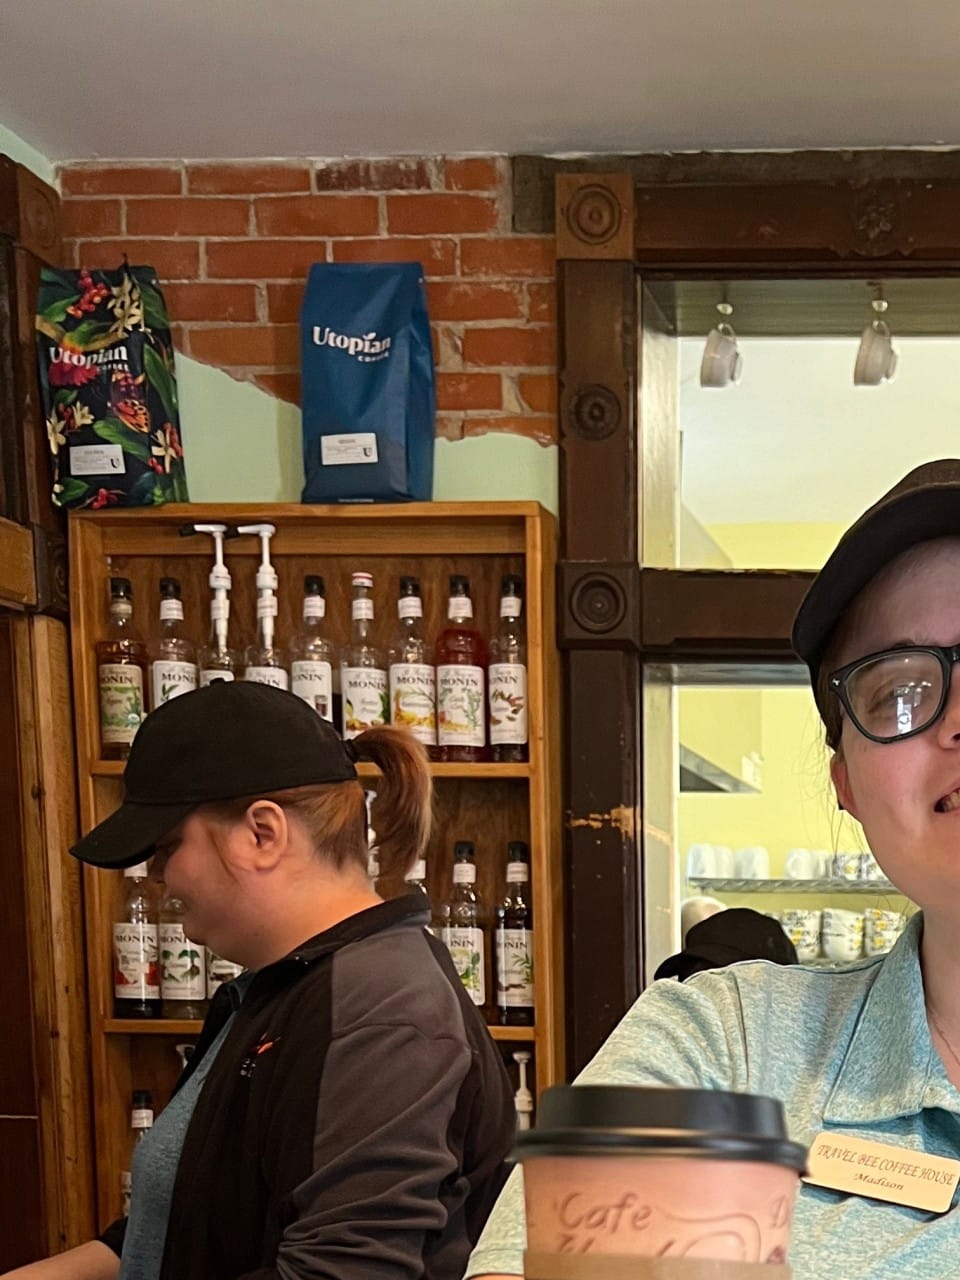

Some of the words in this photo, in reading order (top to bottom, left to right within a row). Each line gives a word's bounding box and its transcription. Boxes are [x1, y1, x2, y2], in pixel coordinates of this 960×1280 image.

[312, 326, 392, 355] Utopian
[49, 345, 129, 369] Utopian
[817, 1144, 856, 1163] TRAVEL
[857, 1153, 881, 1169] BEE
[880, 1158, 920, 1178] COFFEE
[918, 1167, 956, 1186] HOUSE
[853, 1172, 904, 1191] Madison
[556, 1192, 653, 1234] Cafe
